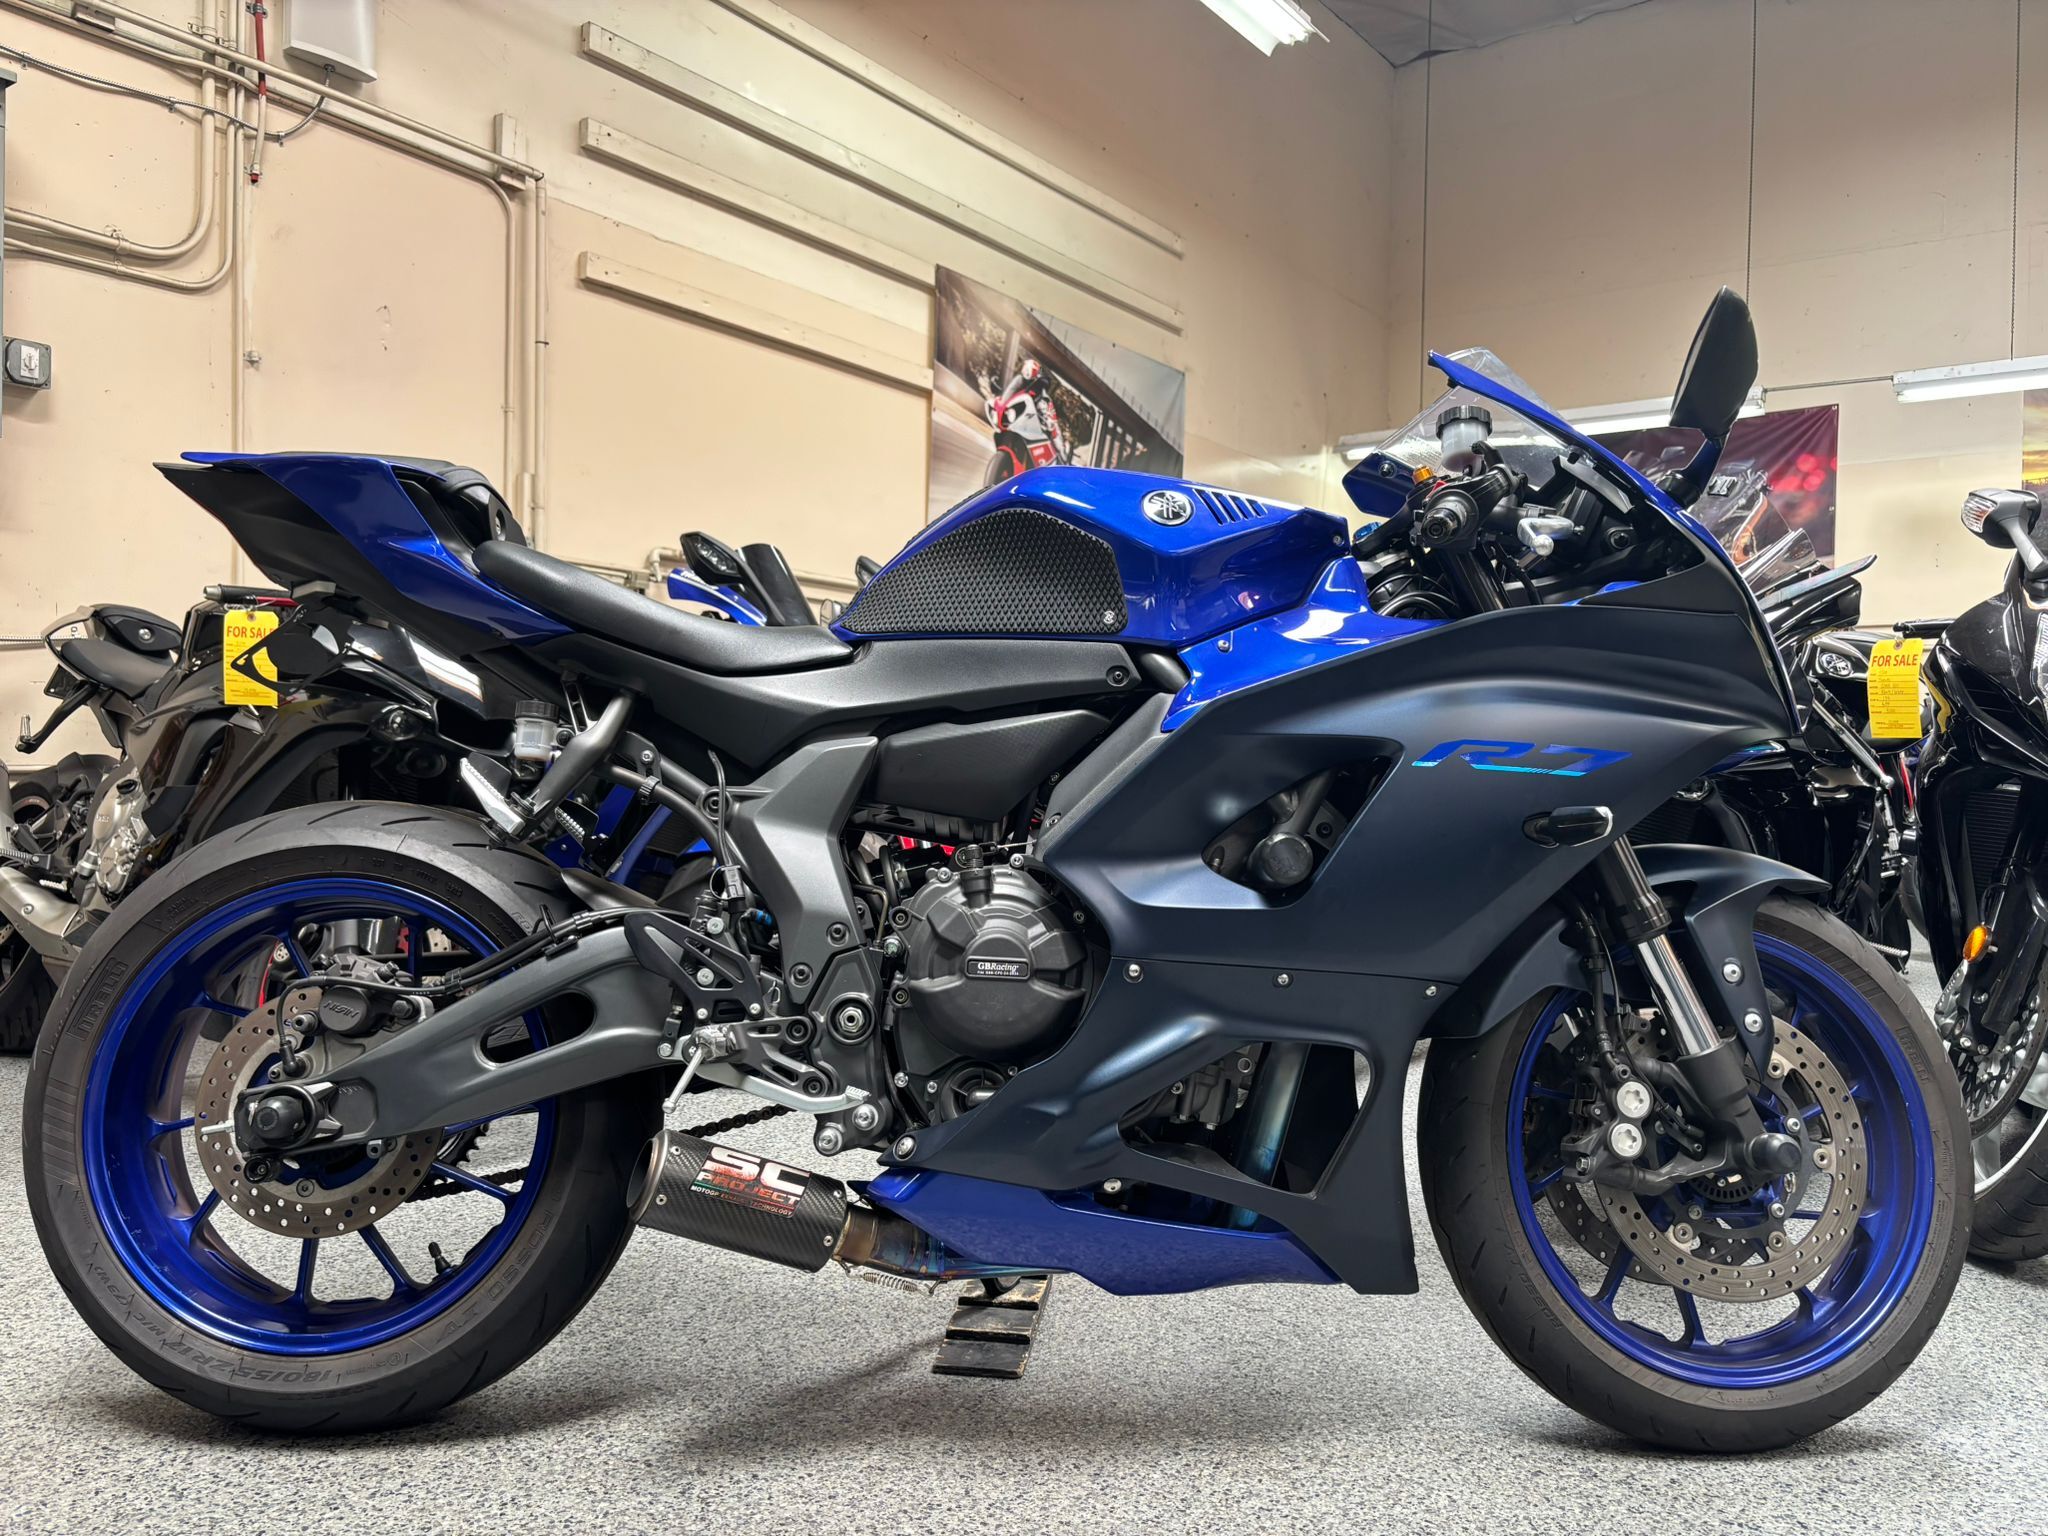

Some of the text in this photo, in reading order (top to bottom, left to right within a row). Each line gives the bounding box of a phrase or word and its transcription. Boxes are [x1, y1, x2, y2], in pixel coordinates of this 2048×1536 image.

[226, 626, 247, 638] FOR
[1871, 654, 1918, 667] FOR SALE
[1411, 739, 1632, 777] R7
[977, 962, 1018, 973] GBRacing
[701, 1146, 811, 1196] SC
[696, 1171, 800, 1206] PROJECT
